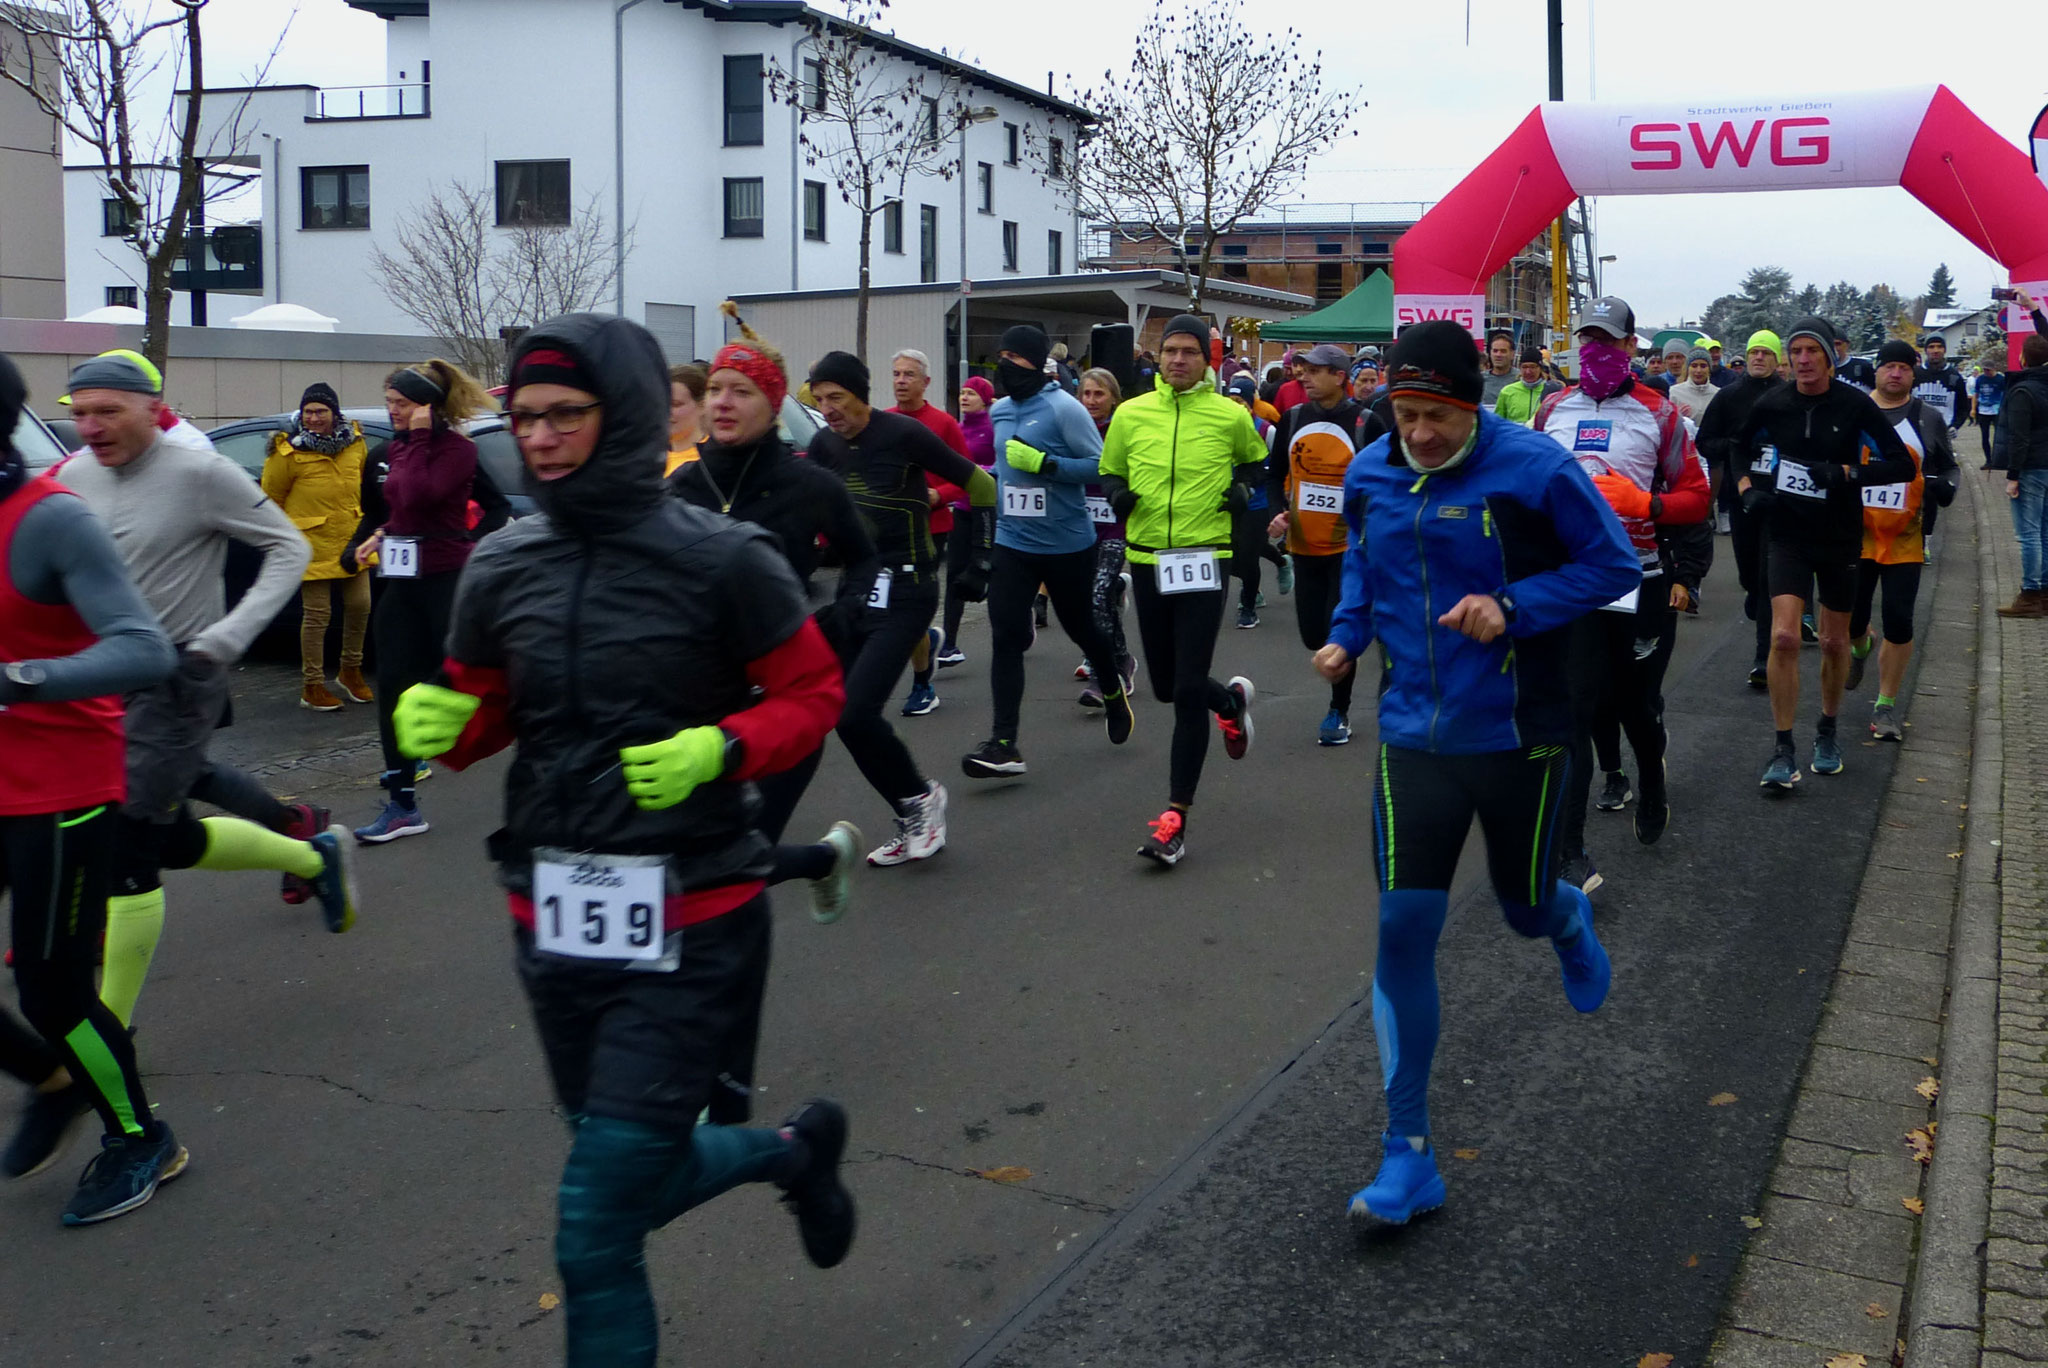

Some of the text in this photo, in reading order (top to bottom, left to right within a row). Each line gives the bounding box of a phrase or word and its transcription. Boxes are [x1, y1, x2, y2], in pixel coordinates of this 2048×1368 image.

[1687, 101, 1833, 116] Stadtwerke Gießen
[1630, 117, 1830, 171] SWG
[1398, 308, 1474, 330] SWG
[1579, 428, 1609, 440] KAPS
[1786, 475, 1820, 495] 234
[1006, 493, 1044, 511] 176
[1306, 493, 1336, 509] 252
[1864, 488, 1902, 506] 147
[390, 548, 409, 566] 78
[1163, 562, 1212, 584] 160
[543, 894, 654, 948] 159
